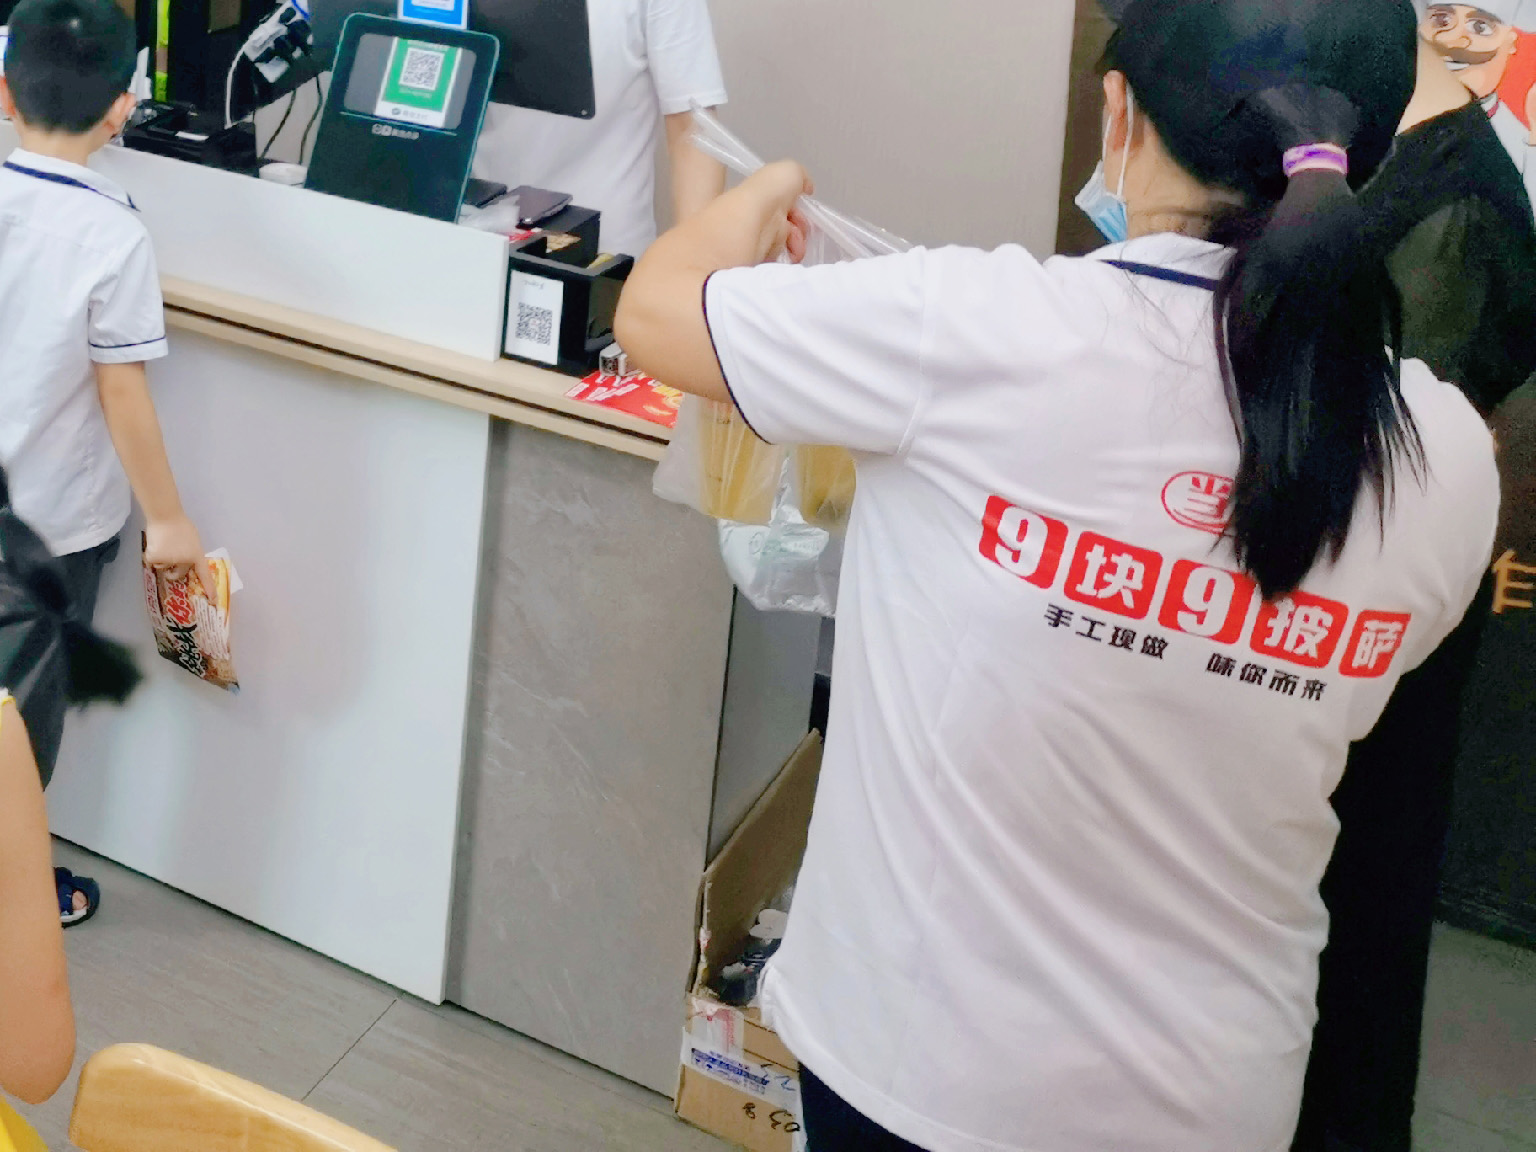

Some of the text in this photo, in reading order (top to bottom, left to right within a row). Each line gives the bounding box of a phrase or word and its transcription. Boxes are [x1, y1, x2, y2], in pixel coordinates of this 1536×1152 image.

[991, 503, 1404, 670] 9块9披萨
[1044, 603, 1168, 659] 手工现做
